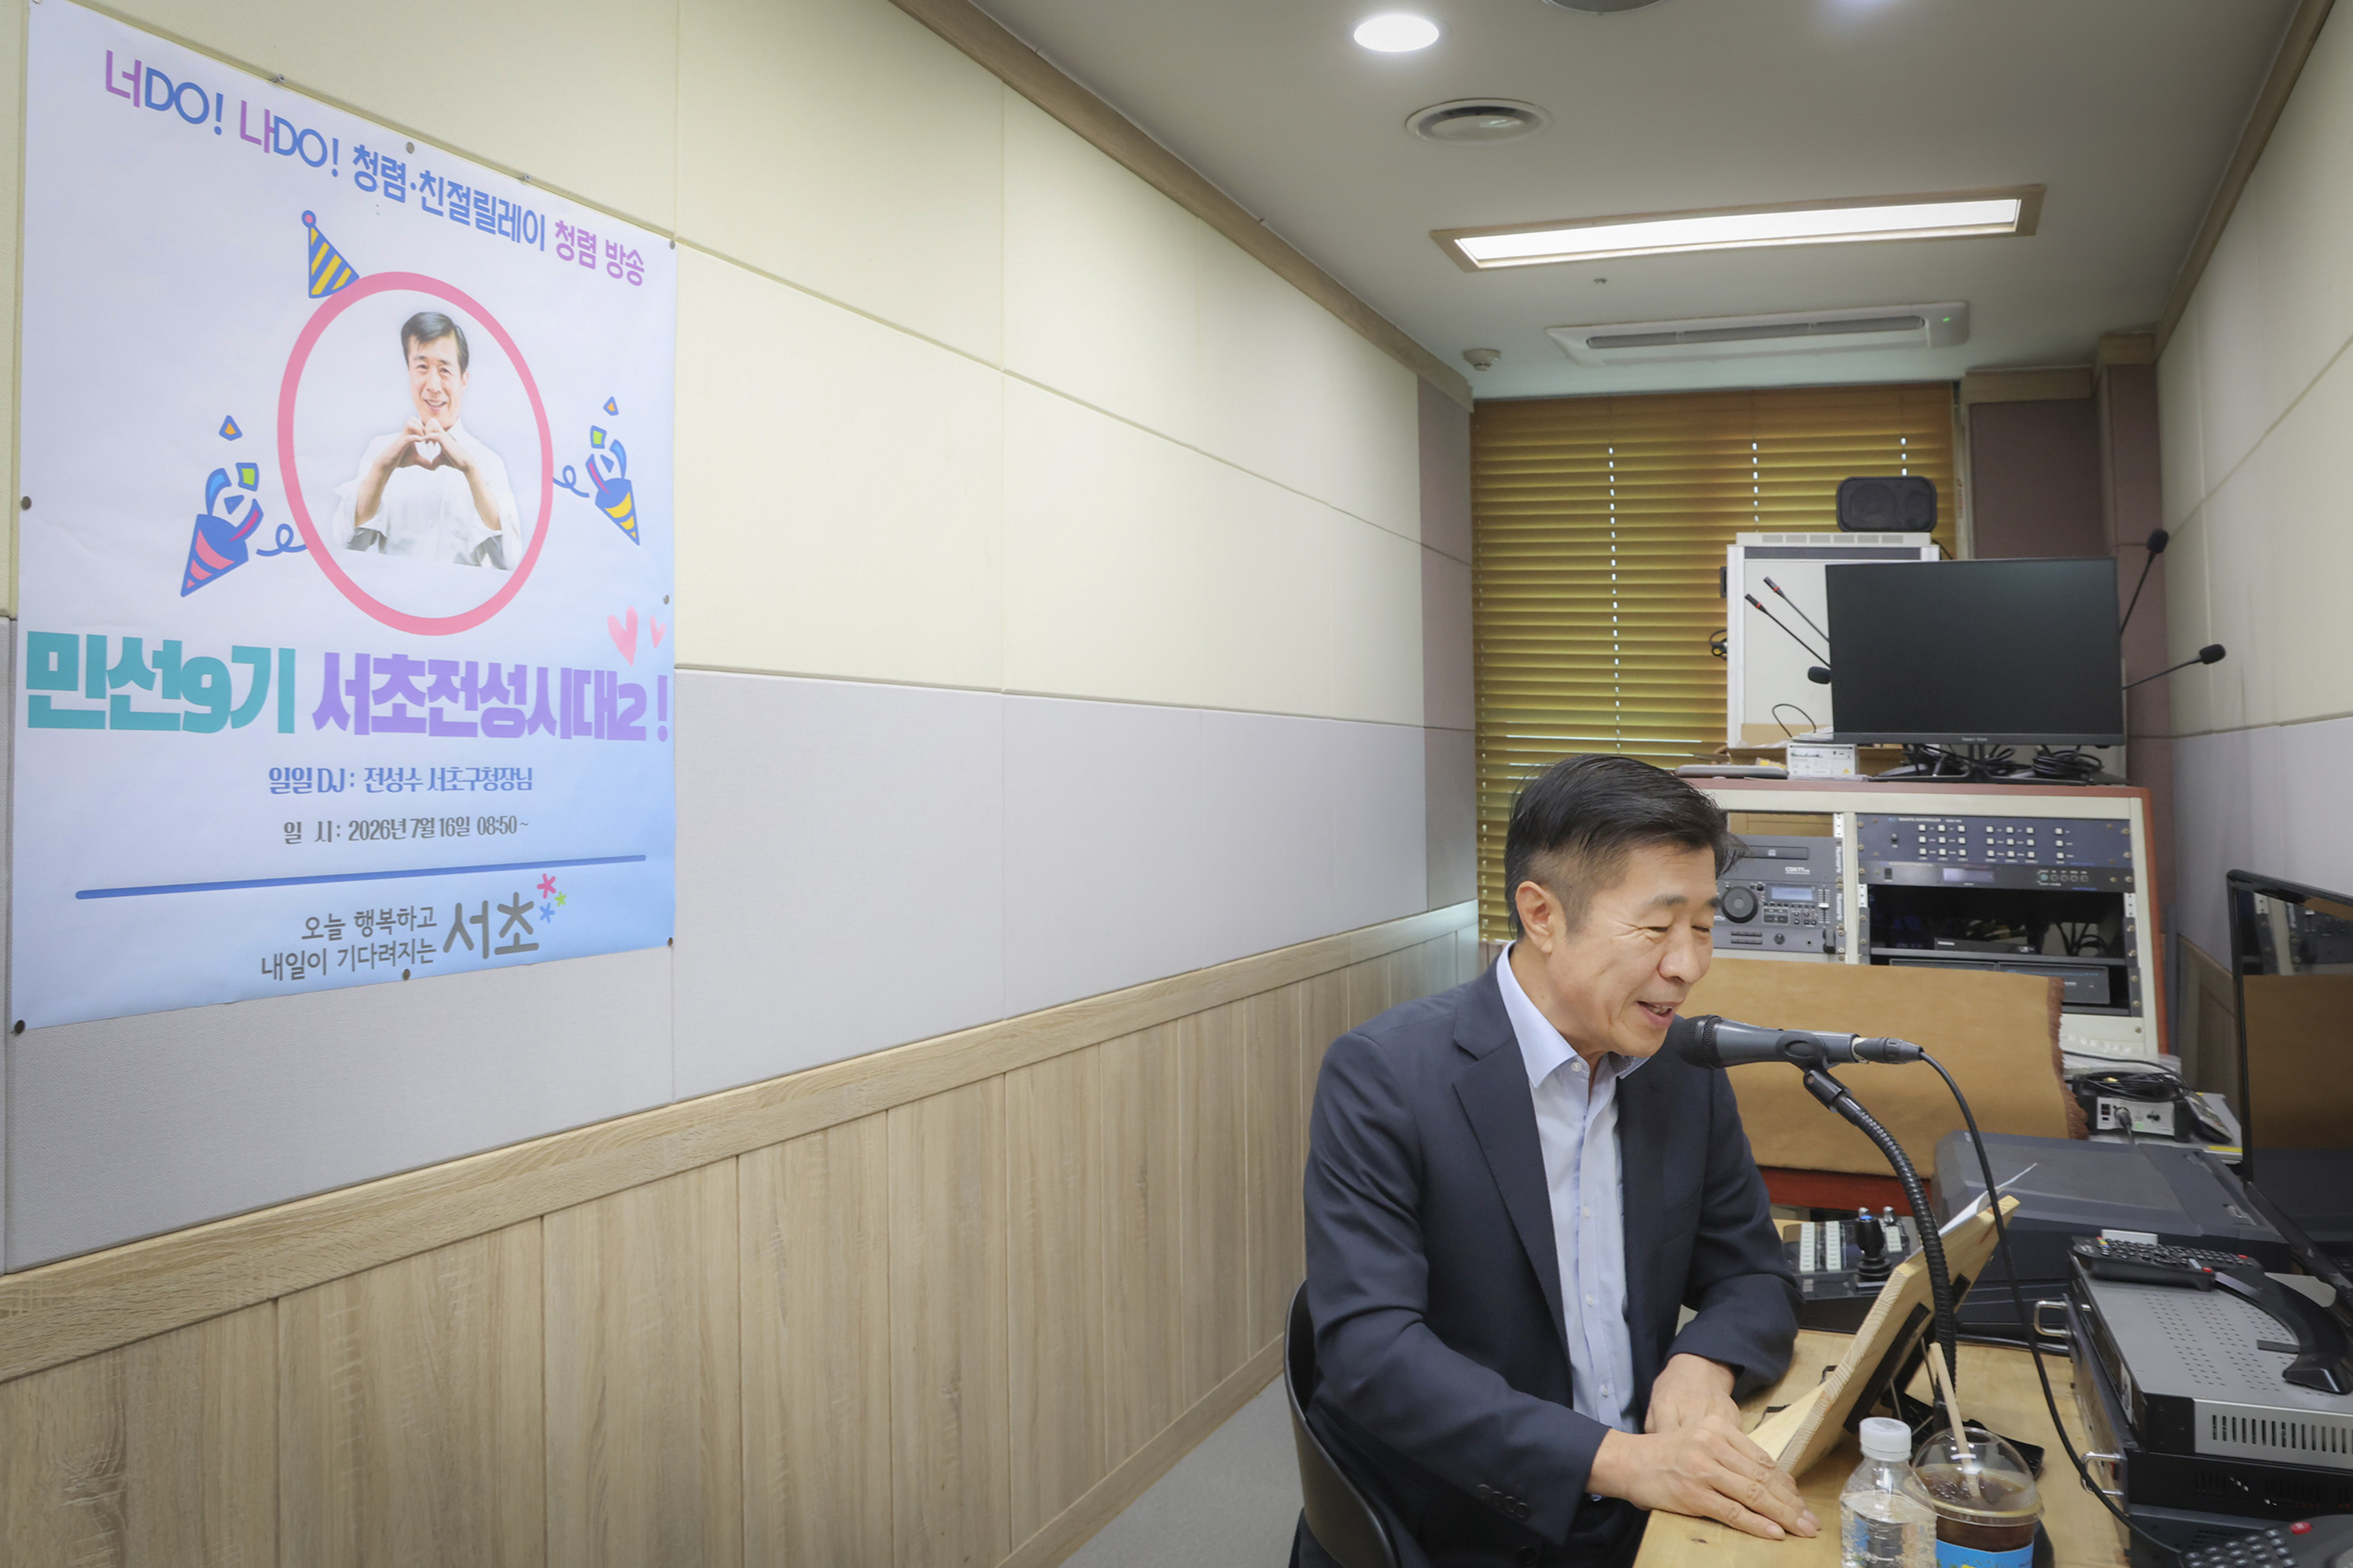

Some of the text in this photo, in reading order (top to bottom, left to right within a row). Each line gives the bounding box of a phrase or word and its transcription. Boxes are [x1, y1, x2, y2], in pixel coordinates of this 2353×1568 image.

[105, 49, 224, 136] 너DO!
[239, 99, 339, 178] 나DO!
[554, 220, 598, 271] 청렴
[605, 239, 646, 287] 방송
[26, 630, 668, 742] 민선9기 서초전성시대2!
[268, 766, 533, 795] 일일 DJ: 전성수 서초구청장님
[348, 817, 407, 842] 2026년
[410, 817, 436, 839] 7월
[438, 816, 471, 837] 16일
[301, 905, 438, 942] 오늘 행복하고
[442, 891, 540, 960] 서초
[261, 938, 438, 981] 내일이 기다려지는
